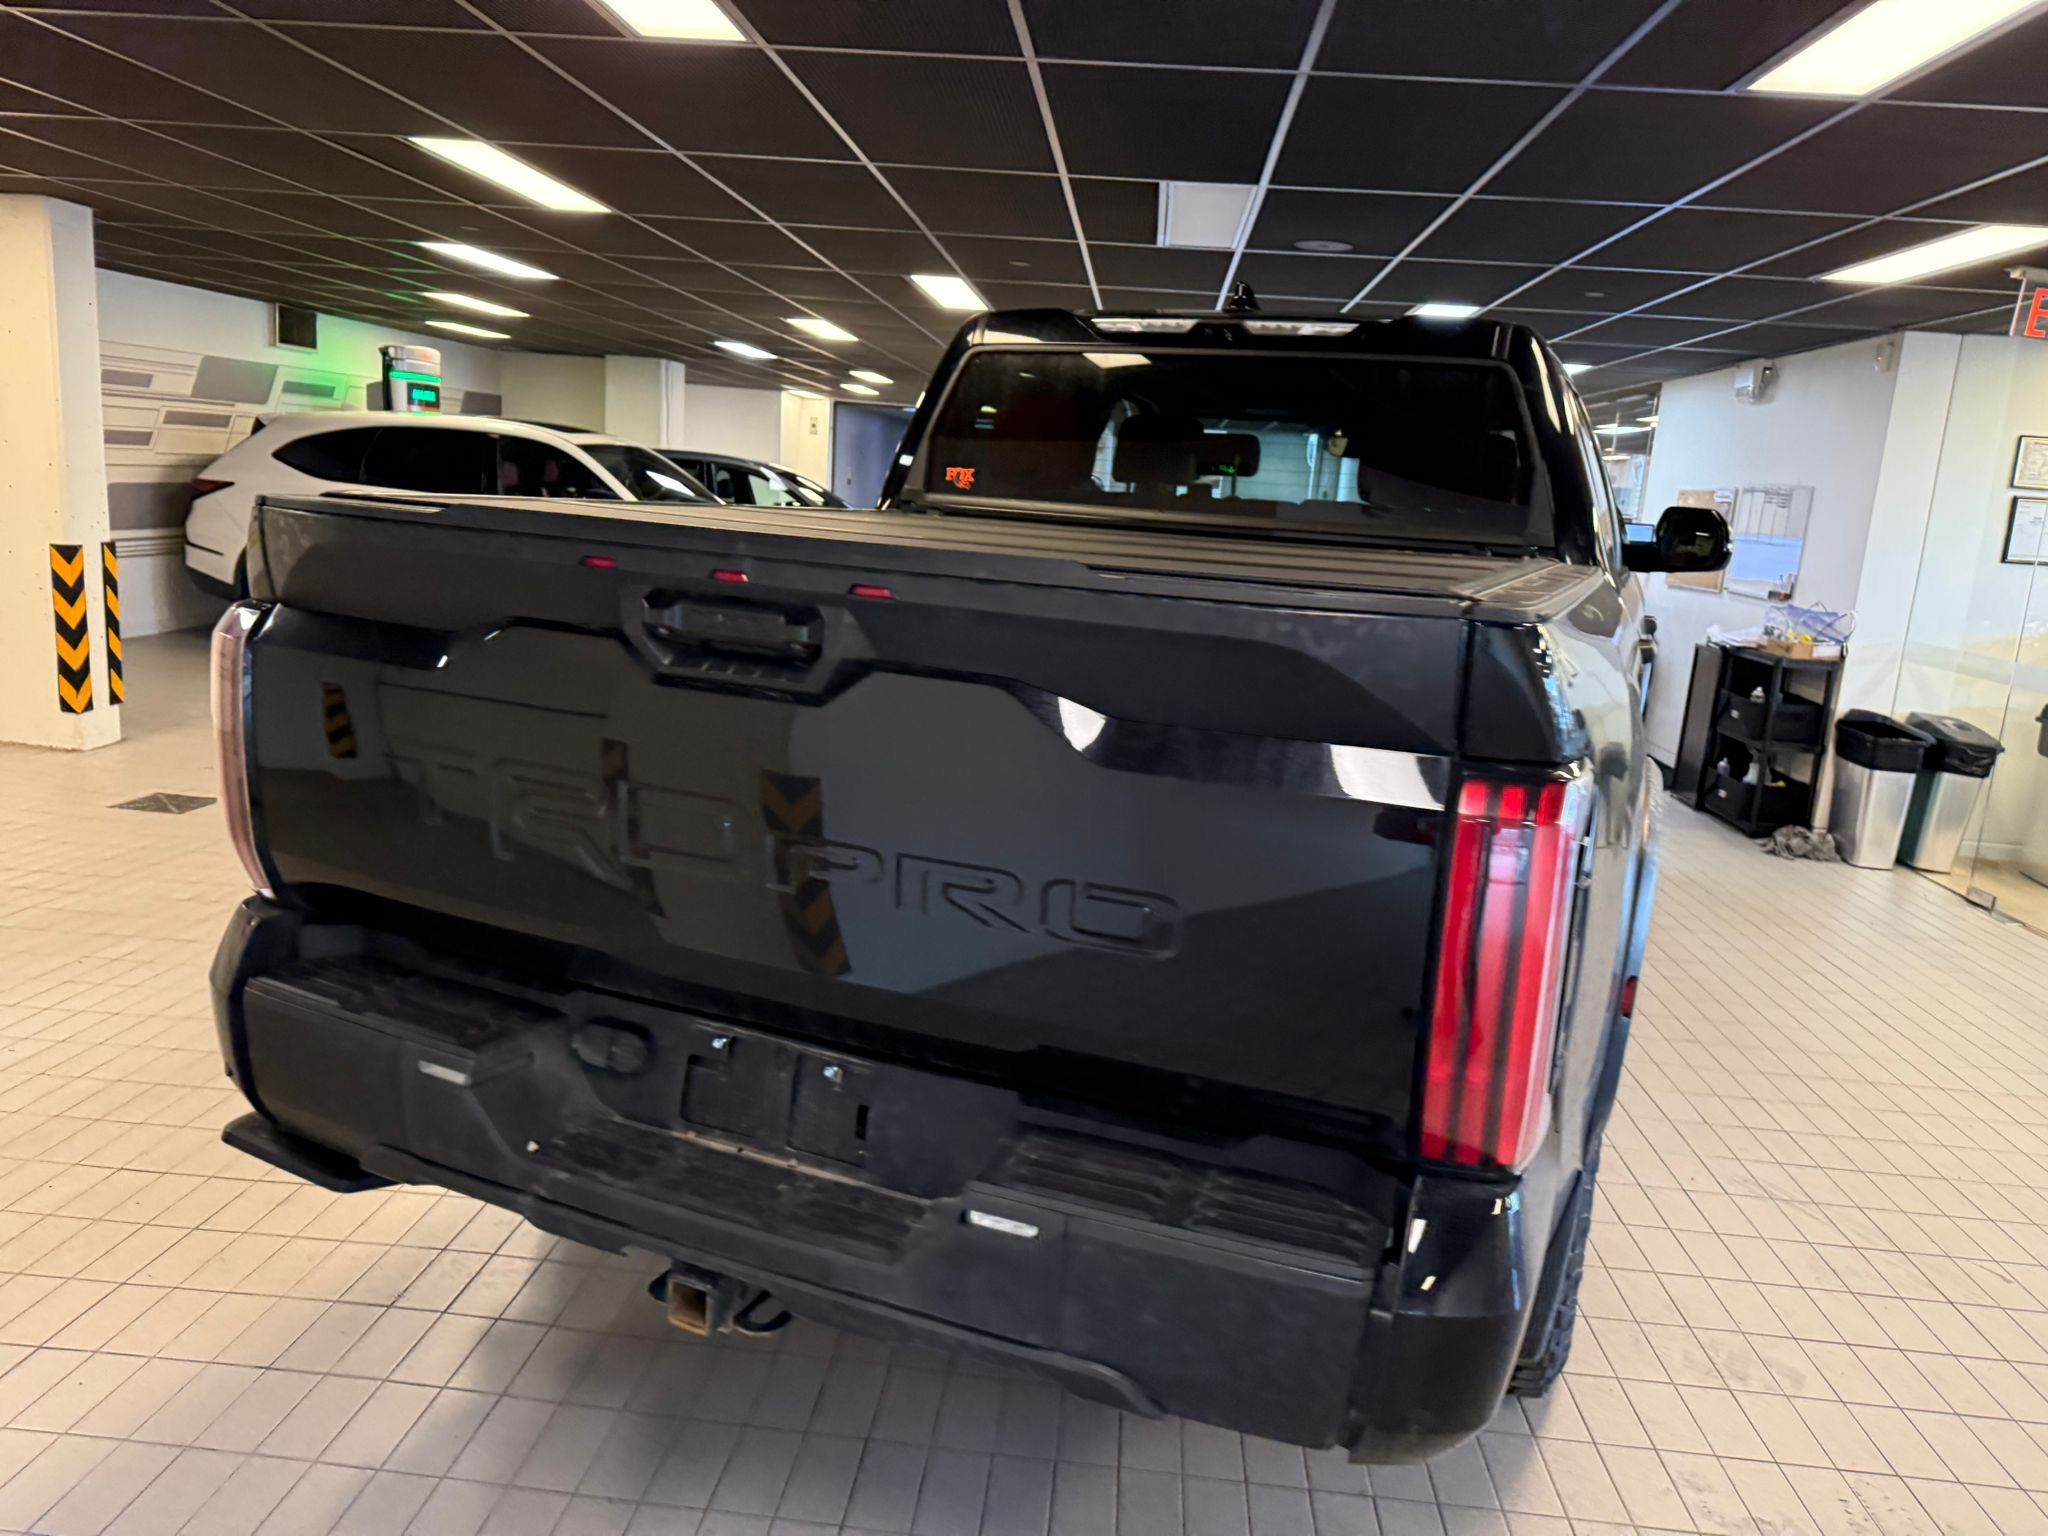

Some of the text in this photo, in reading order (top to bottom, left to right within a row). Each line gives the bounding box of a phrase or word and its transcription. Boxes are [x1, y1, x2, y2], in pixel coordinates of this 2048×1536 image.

[945, 467, 976, 490] FOX
[384, 736, 1182, 958] TRD PRO
